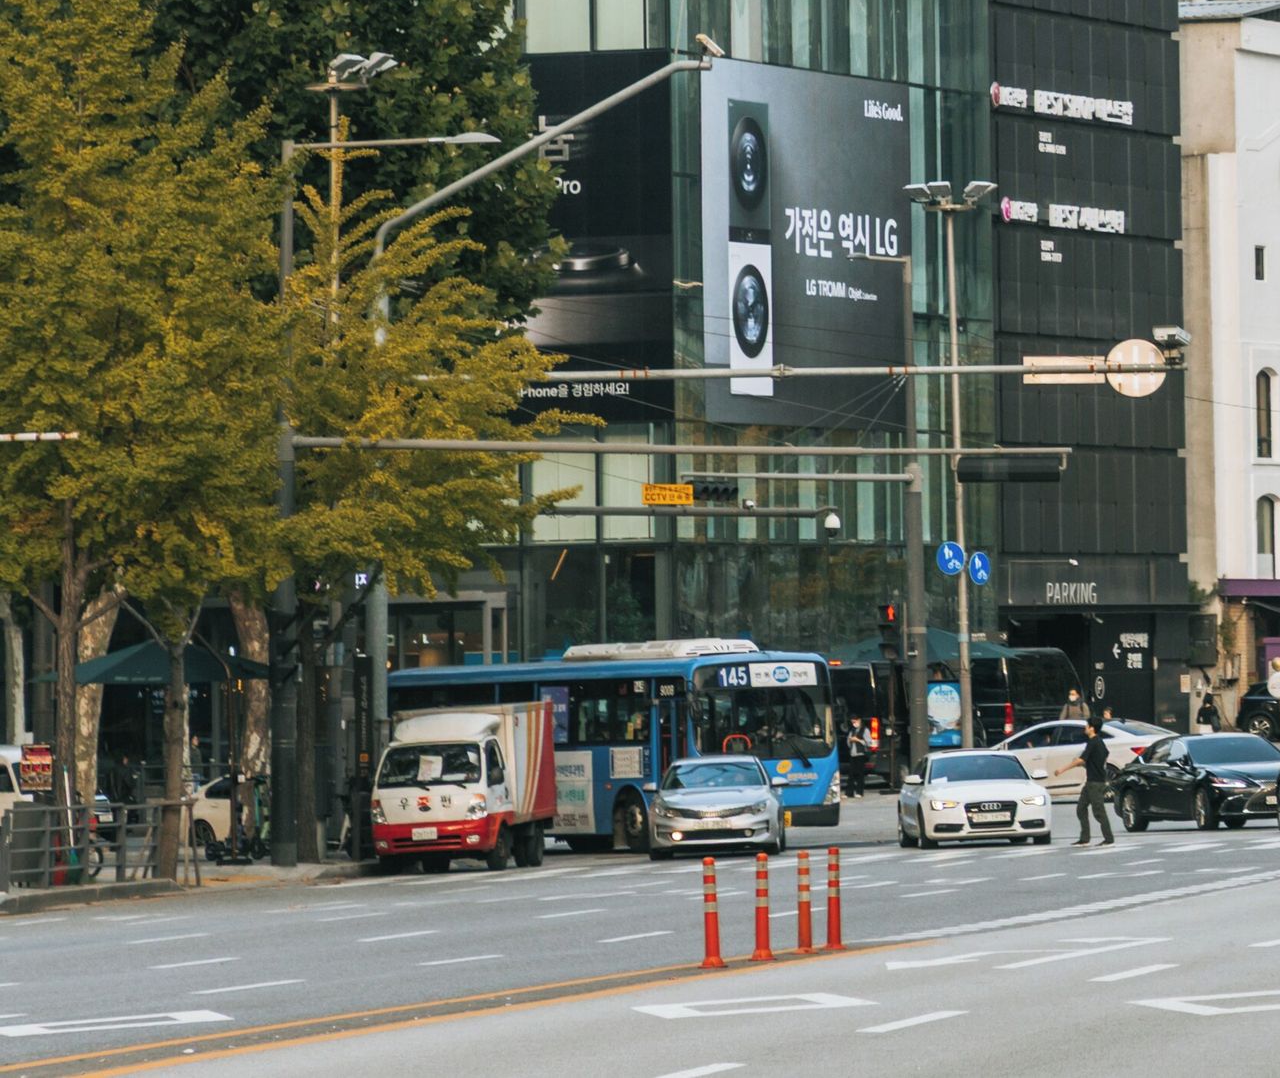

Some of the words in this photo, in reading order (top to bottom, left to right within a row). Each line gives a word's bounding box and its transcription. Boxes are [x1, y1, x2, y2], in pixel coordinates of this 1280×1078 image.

[863, 99, 882, 120] Life's
[882, 102, 904, 122] Good.
[784, 206, 834, 258] 가전은
[838, 212, 870, 258] 역시
[875, 217, 898, 256] LG
[806, 278, 817, 296] LG
[817, 279, 846, 299] TROMM
[571, 381, 630, 398] 경험하세요!
[644, 493, 667, 502] CCTV
[1045, 581, 1098, 605] PARKING
[719, 666, 748, 687] 145
